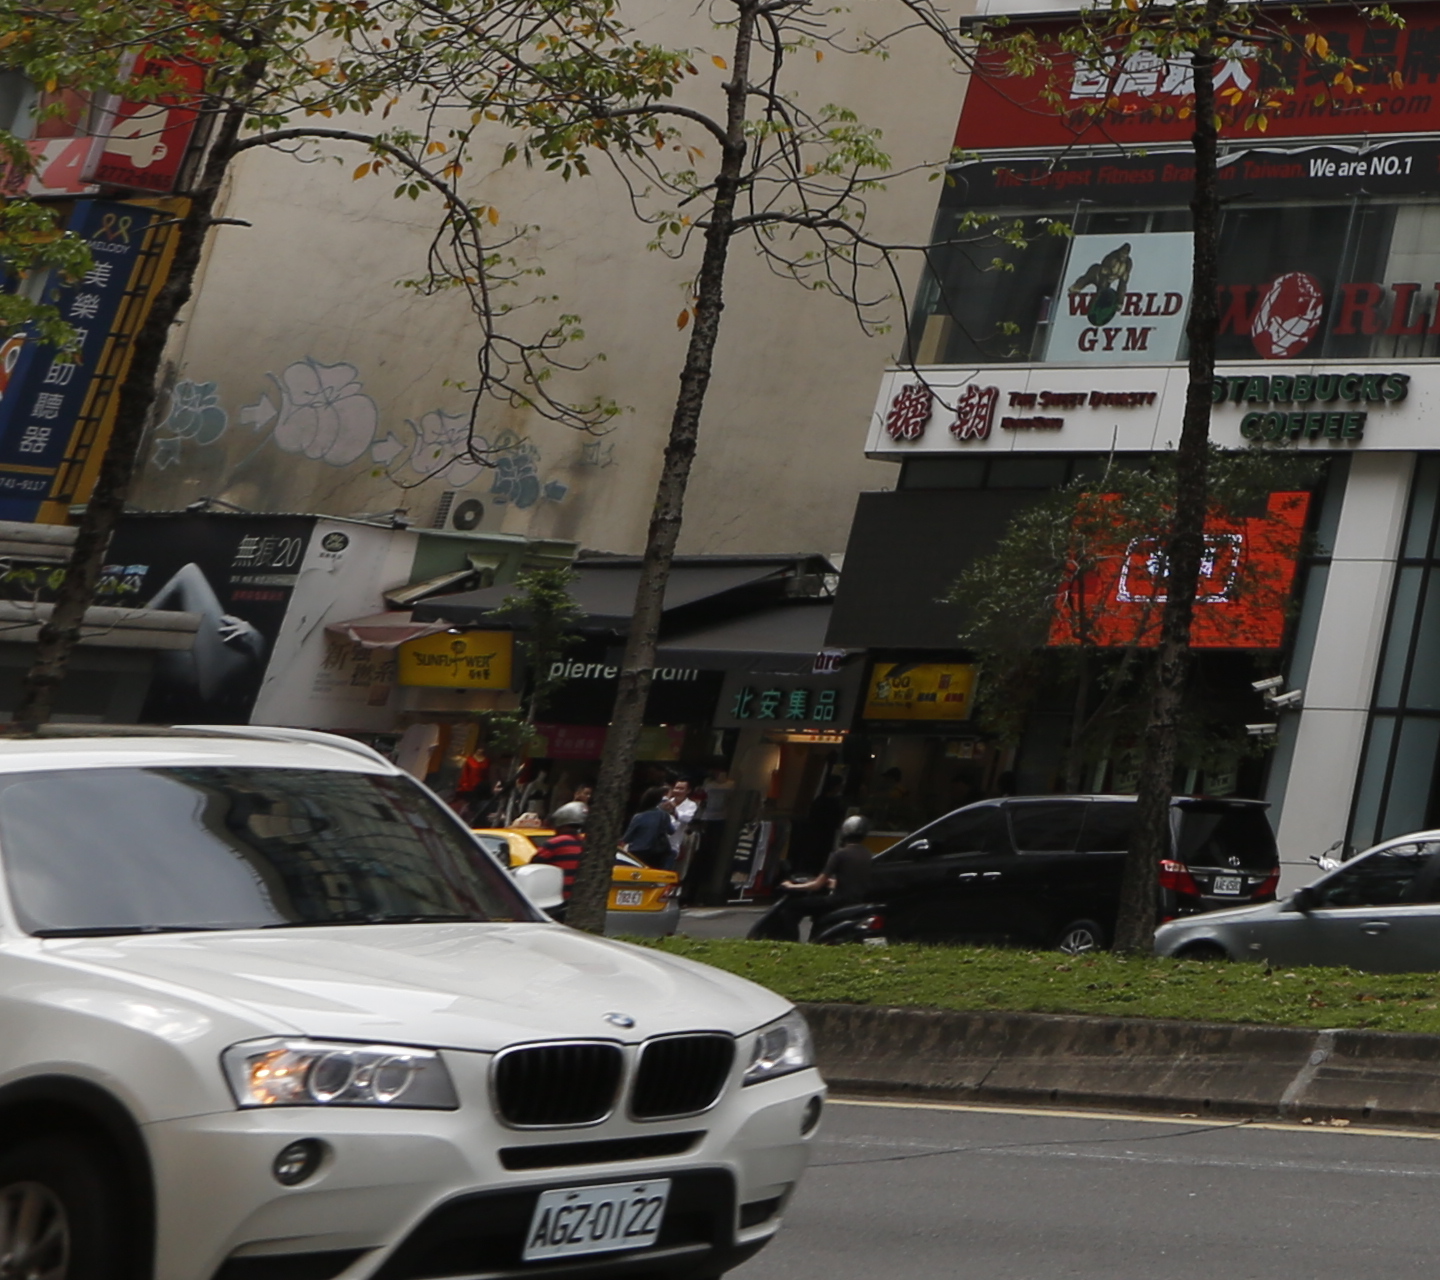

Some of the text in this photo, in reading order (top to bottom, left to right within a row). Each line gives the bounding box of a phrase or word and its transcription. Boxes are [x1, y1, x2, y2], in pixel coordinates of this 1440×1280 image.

[1098, 163, 1156, 184] Fitness
[1161, 161, 1200, 182] Bran
[1309, 158, 1335, 178] We
[1338, 160, 1368, 177] are
[1370, 156, 1414, 177] NO.1
[86, 239, 132, 255] MELODY
[1078, 328, 1150, 352] GYM
[1210, 373, 1410, 405] STARBUCKS
[886, 383, 1000, 441] 糖朝
[1240, 411, 1367, 443] COFFEE
[548, 659, 699, 682] pierre rdin
[730, 687, 837, 723] 北安集品
[529, 1196, 664, 1250] AGZ-0122
